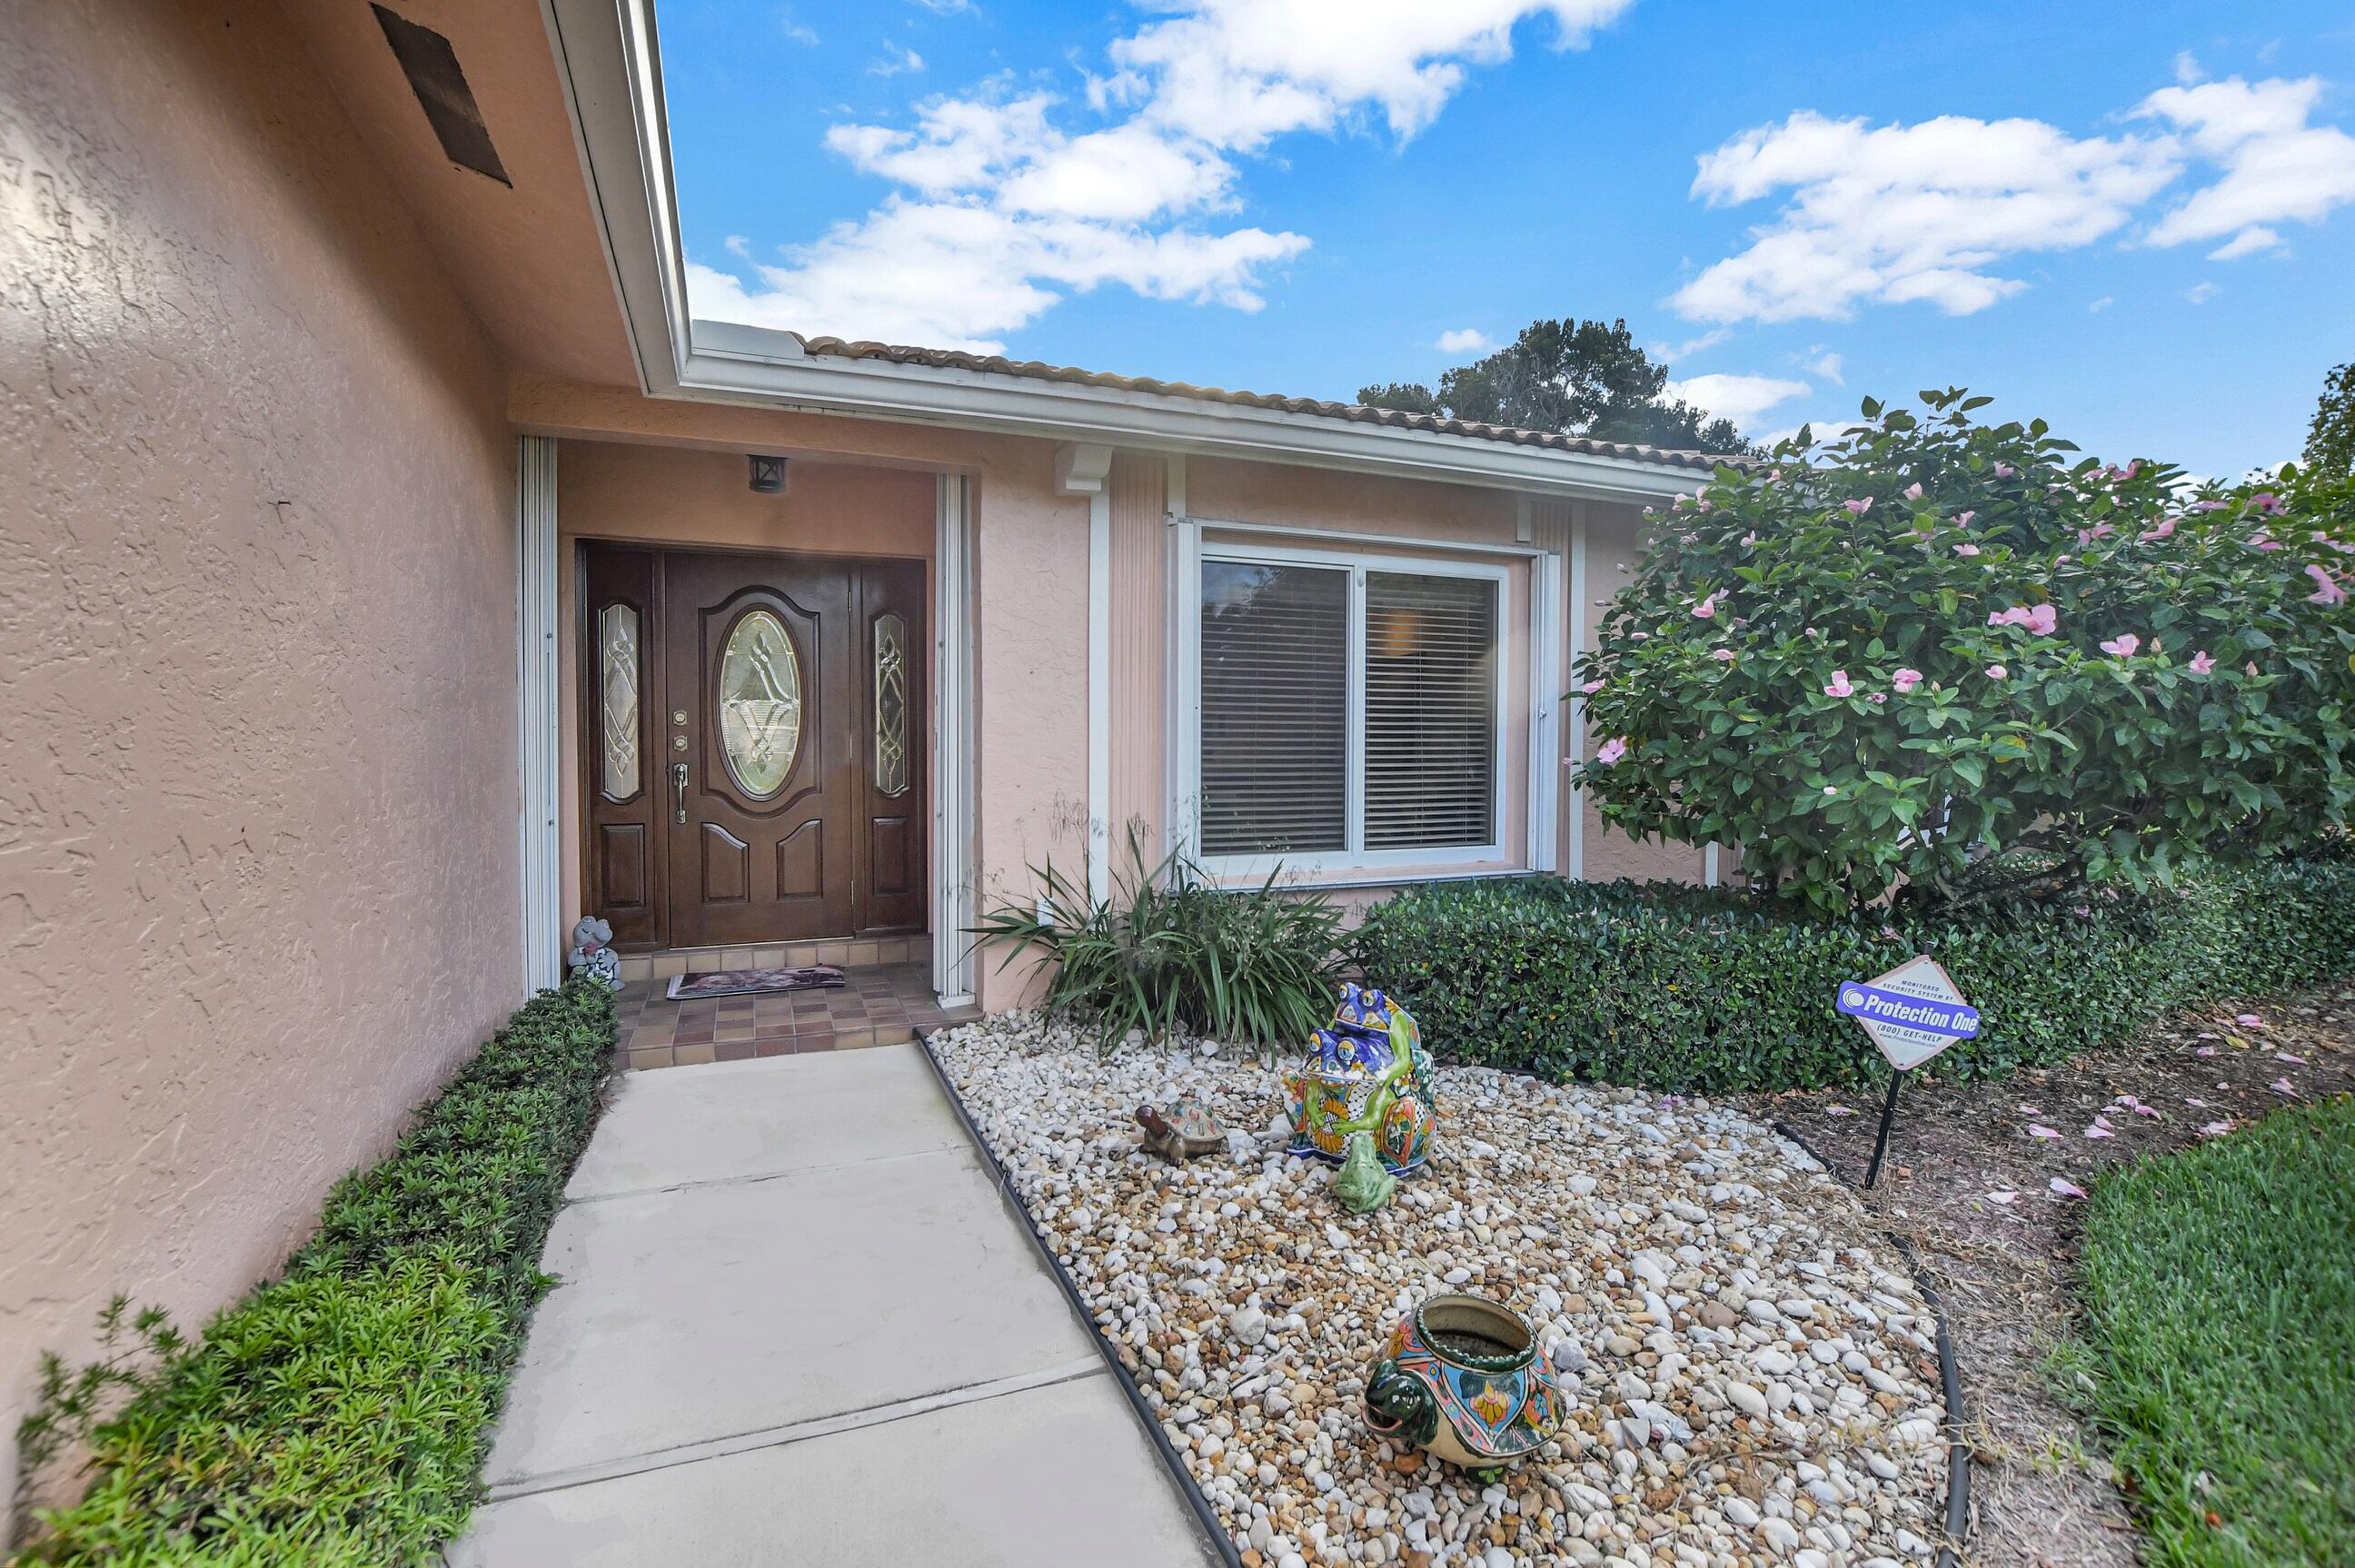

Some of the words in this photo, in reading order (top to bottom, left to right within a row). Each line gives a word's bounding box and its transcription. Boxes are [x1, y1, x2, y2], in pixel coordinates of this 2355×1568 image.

[1883, 983, 1915, 994] SECURITY
[1918, 991, 1943, 999] SYSTEM
[1902, 980, 1940, 992] MONITORED
[1863, 994, 1950, 1027] Protection
[1951, 1011, 1978, 1032] One
[1877, 1024, 1900, 1036] (800)
[1903, 1029, 1943, 1042] GET-HELP
